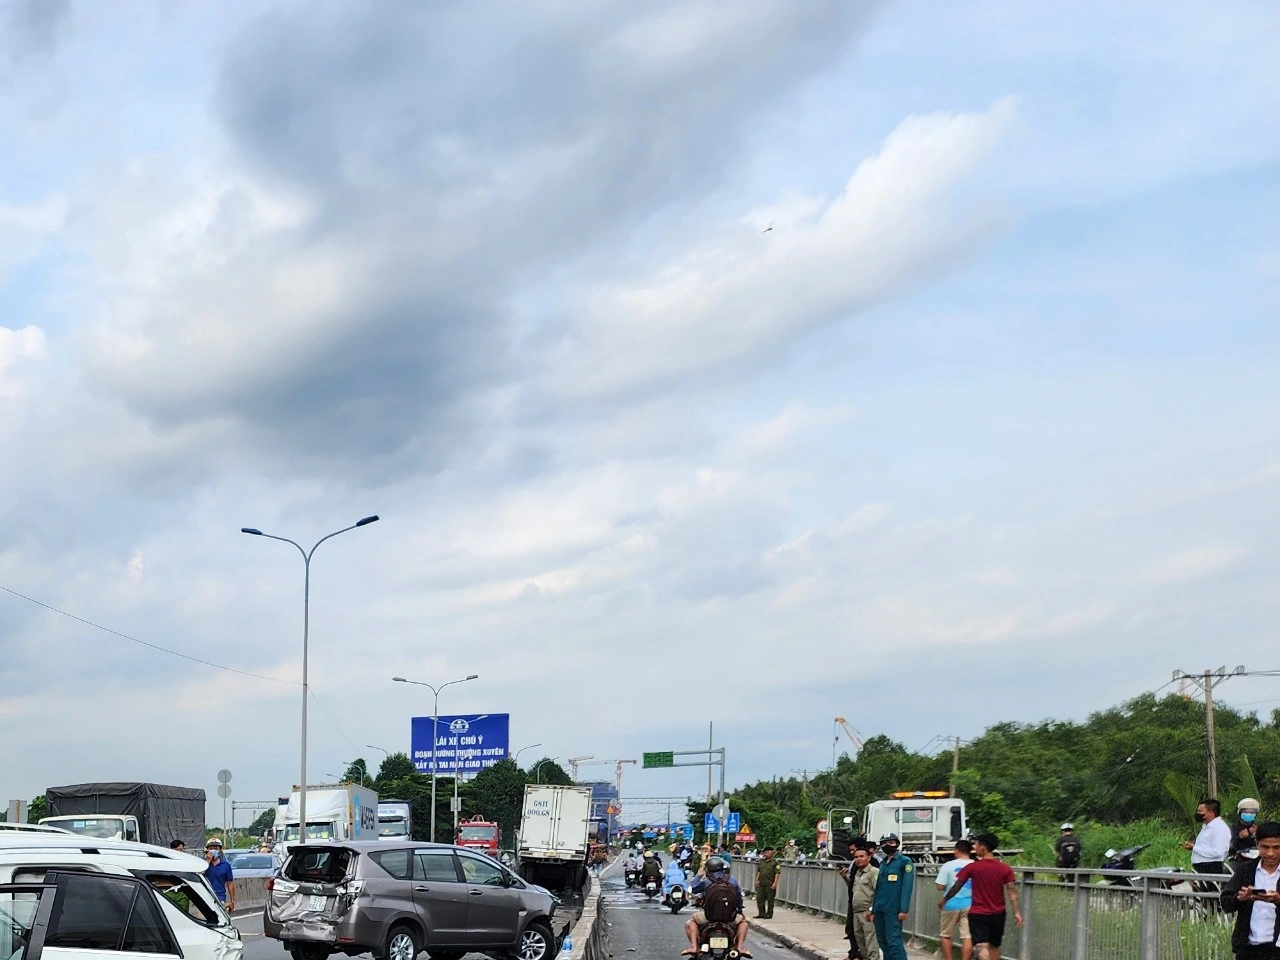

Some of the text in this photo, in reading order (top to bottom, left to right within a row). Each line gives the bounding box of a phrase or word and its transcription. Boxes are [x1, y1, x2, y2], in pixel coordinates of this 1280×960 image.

[460, 735, 477, 745] CHÚ
[482, 746, 504, 757] XUYÊN
[464, 759, 481, 769] GIAO
